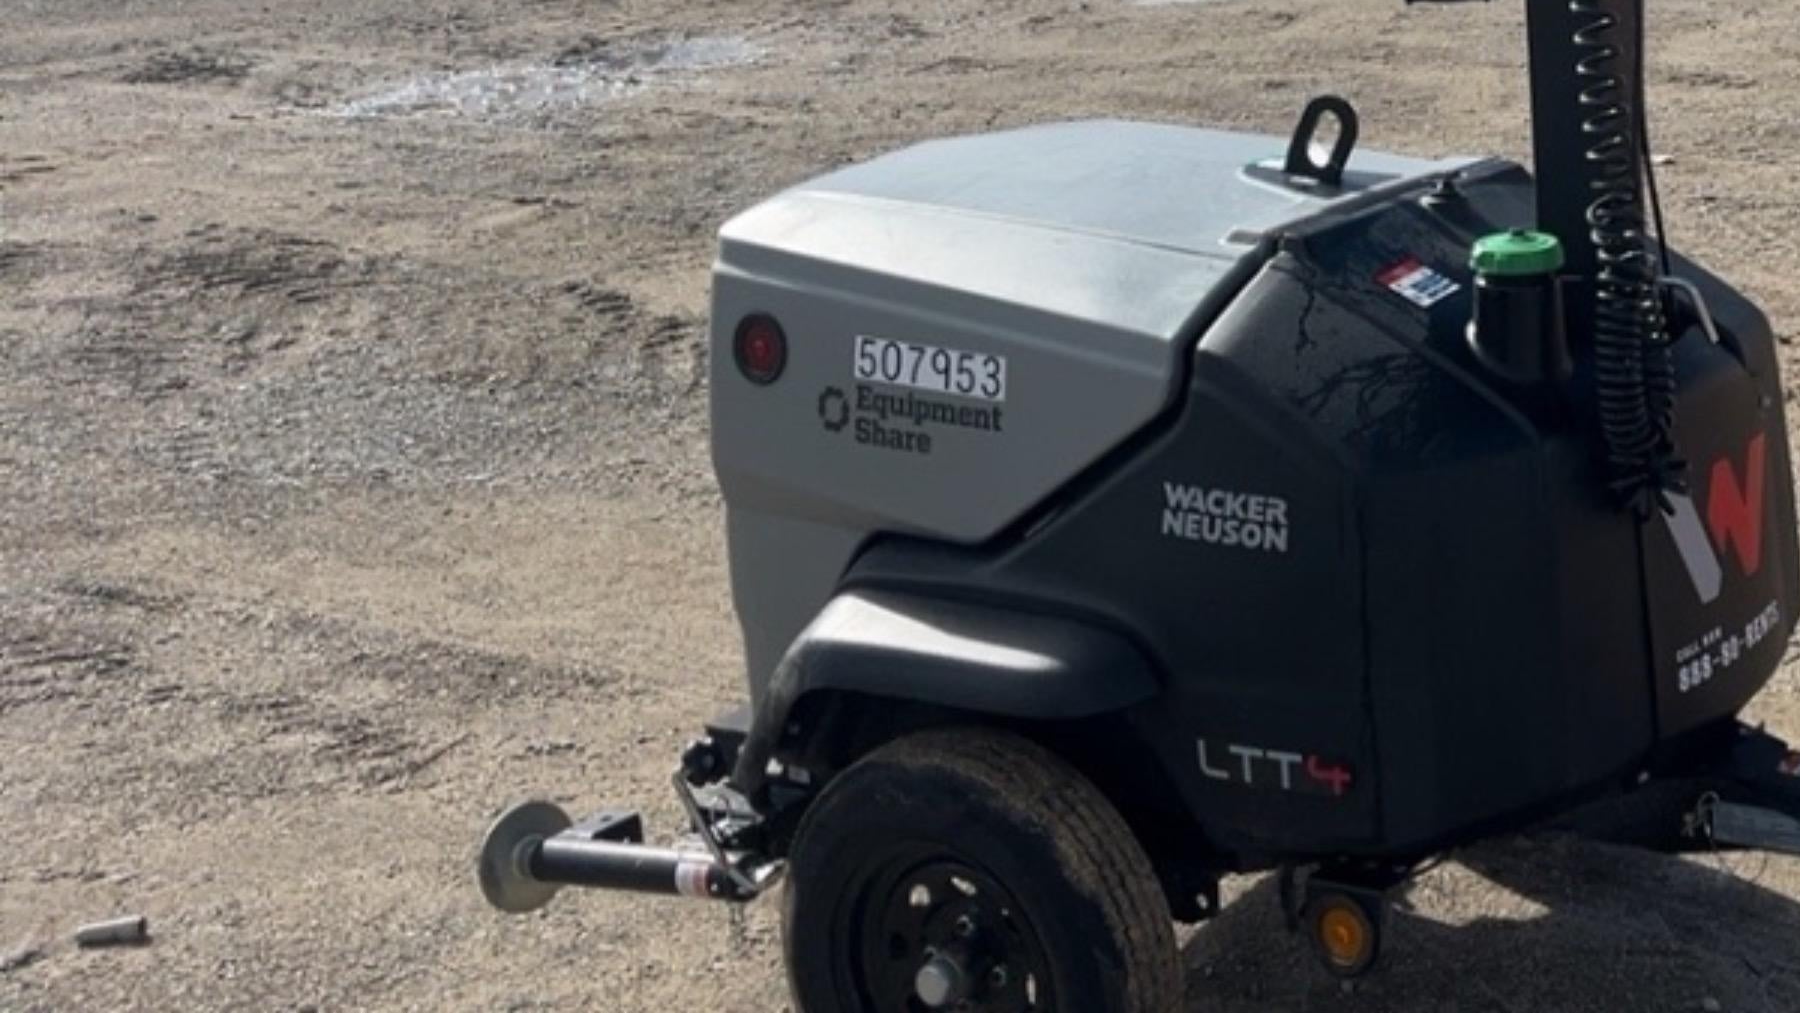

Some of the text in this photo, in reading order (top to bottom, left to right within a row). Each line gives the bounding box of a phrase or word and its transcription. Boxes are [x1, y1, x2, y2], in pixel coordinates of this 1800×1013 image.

[857, 338, 1001, 399] 507953
[856, 385, 1003, 433] Equipment
[854, 416, 932, 454] Share
[1162, 481, 1289, 525] WACKER
[1161, 508, 1289, 552] NEUSON
[1197, 738, 1351, 796] LTT4
